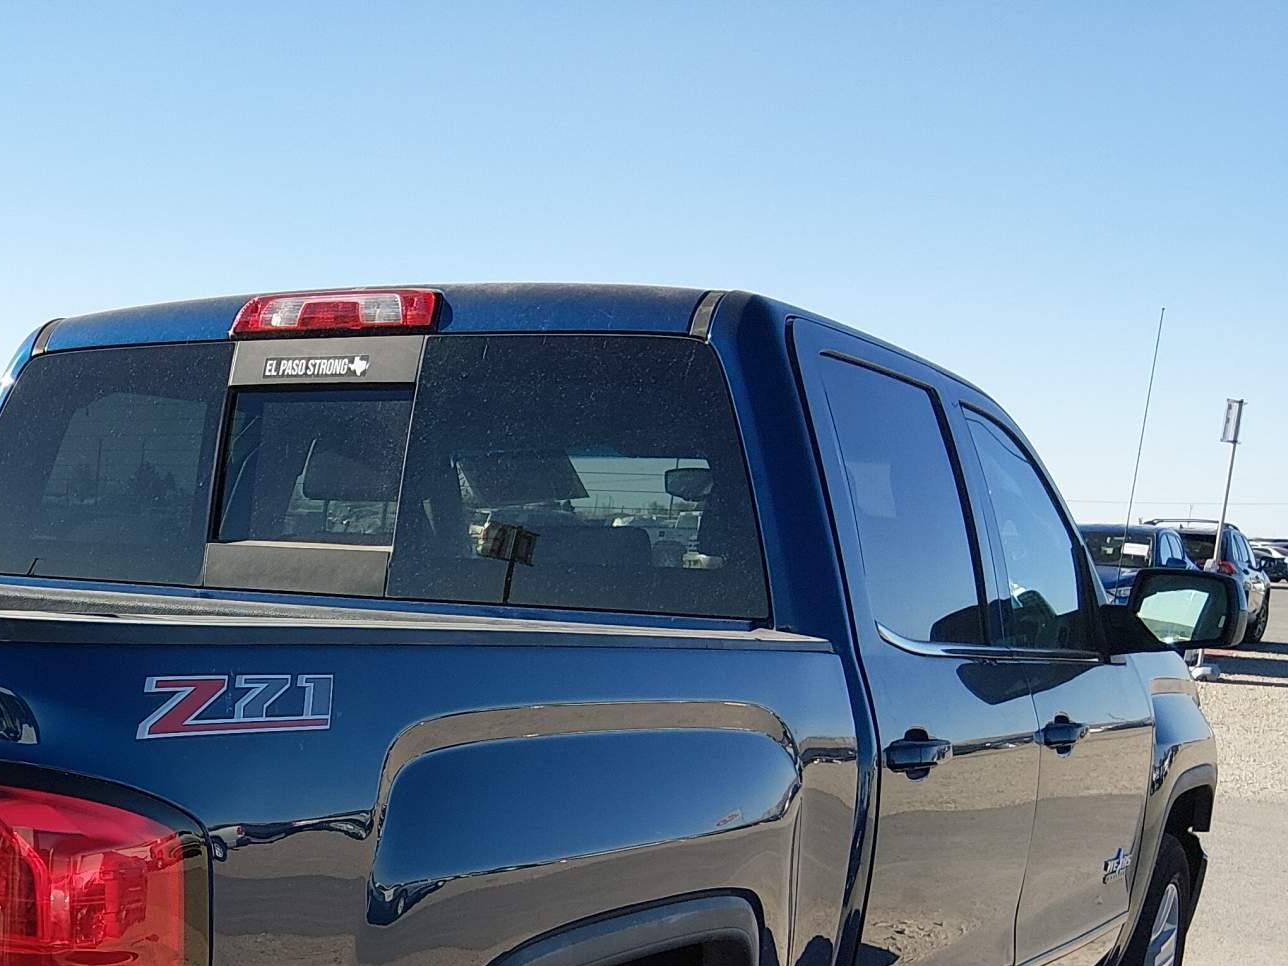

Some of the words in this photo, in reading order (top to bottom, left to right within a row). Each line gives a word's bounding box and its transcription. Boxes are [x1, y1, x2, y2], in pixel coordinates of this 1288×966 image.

[265, 360, 278, 376] EL
[279, 359, 305, 376] PASO
[306, 358, 348, 375] STRONG
[136, 674, 334, 740] Z71
